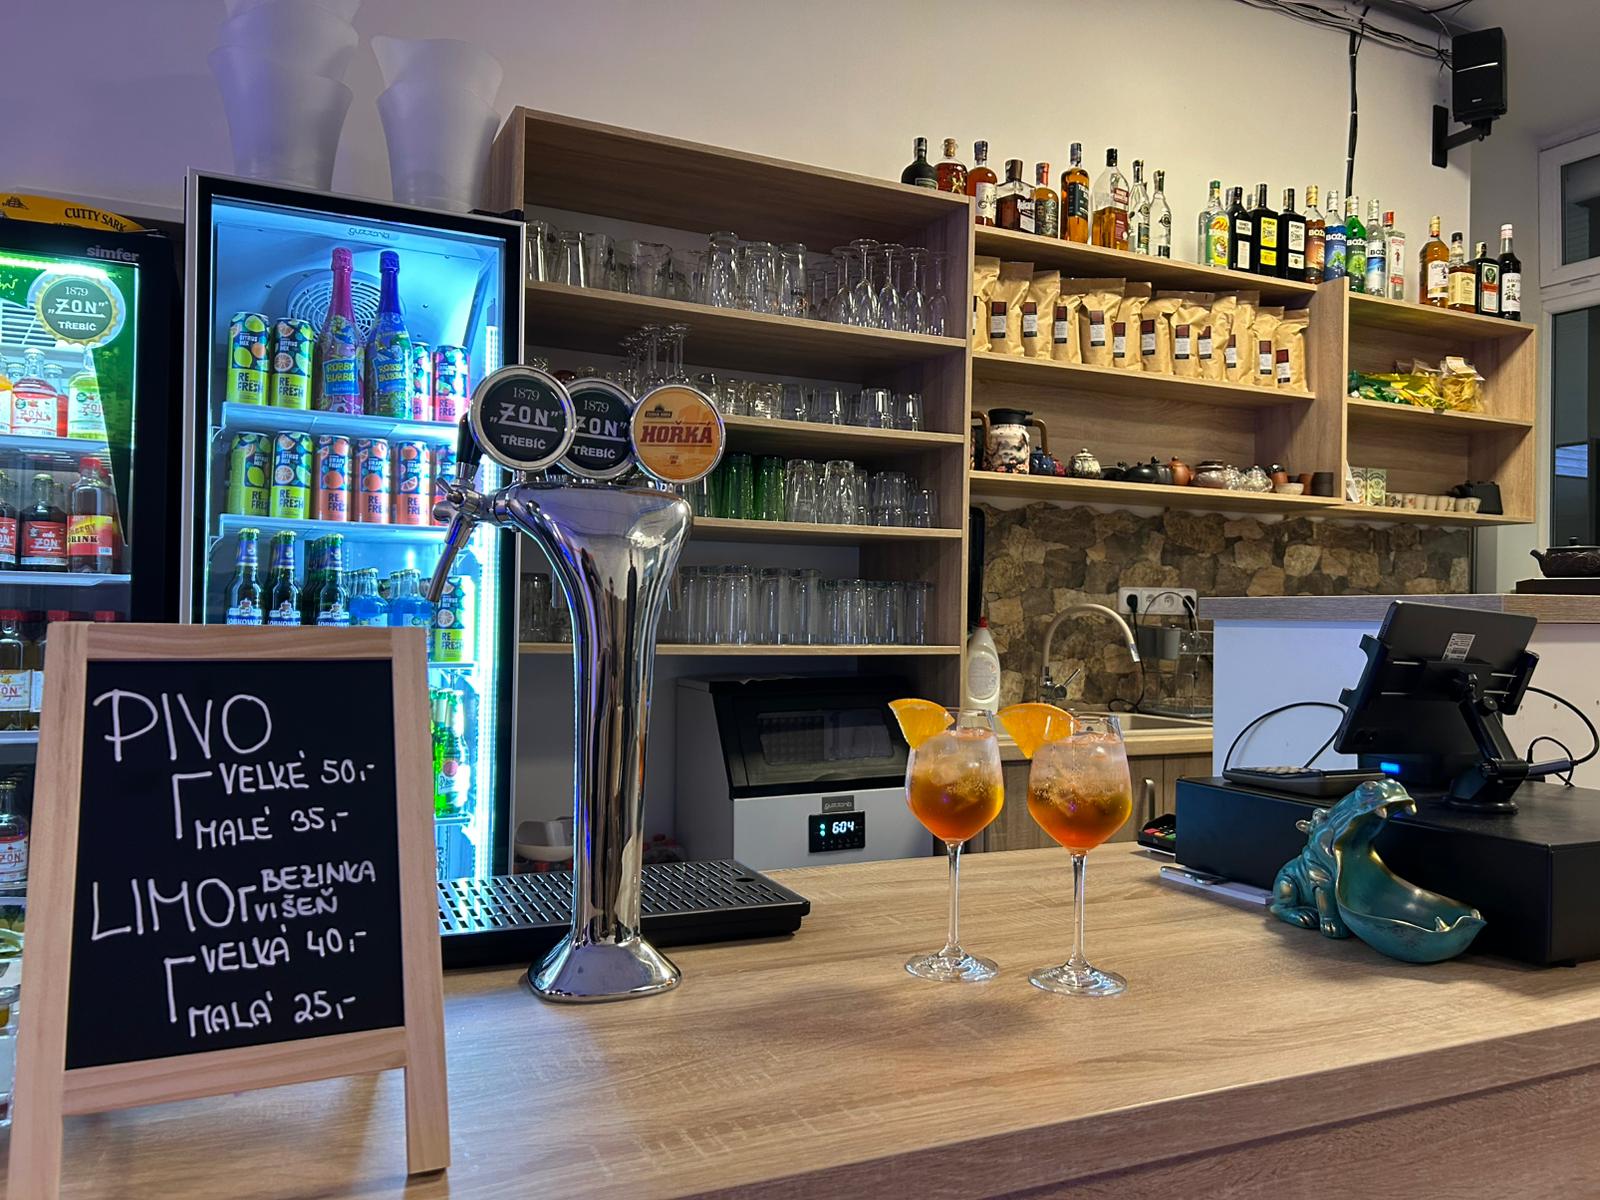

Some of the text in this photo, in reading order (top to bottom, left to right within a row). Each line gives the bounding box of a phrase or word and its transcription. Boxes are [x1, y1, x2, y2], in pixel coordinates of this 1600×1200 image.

[64, 207, 127, 232] CUTTY SARK
[86, 245, 140, 262] simfer
[65, 286, 89, 297] 1879
[238, 373, 249, 382] RE
[279, 377, 291, 386] RE
[279, 386, 304, 397] FRESH
[513, 387, 540, 401] 1879
[583, 400, 610, 413] 1879
[639, 420, 713, 444] HOŘKÁ
[252, 491, 263, 500] RE
[279, 490, 291, 498] RE
[328, 493, 339, 502] RE
[367, 495, 379, 504] RE
[279, 498, 304, 508] FRESH
[407, 497, 418, 506] RE
[441, 632, 452, 641] RE
[93, 688, 272, 763] PIVO
[219, 750, 309, 795] VELKÉ
[194, 806, 273, 849] MALÉ
[91, 860, 377, 941] LIMO BEZINKA
[254, 887, 338, 922] VIŠEŇ
[201, 924, 291, 973] VELKÁ
[188, 991, 273, 1038] MALÁ
